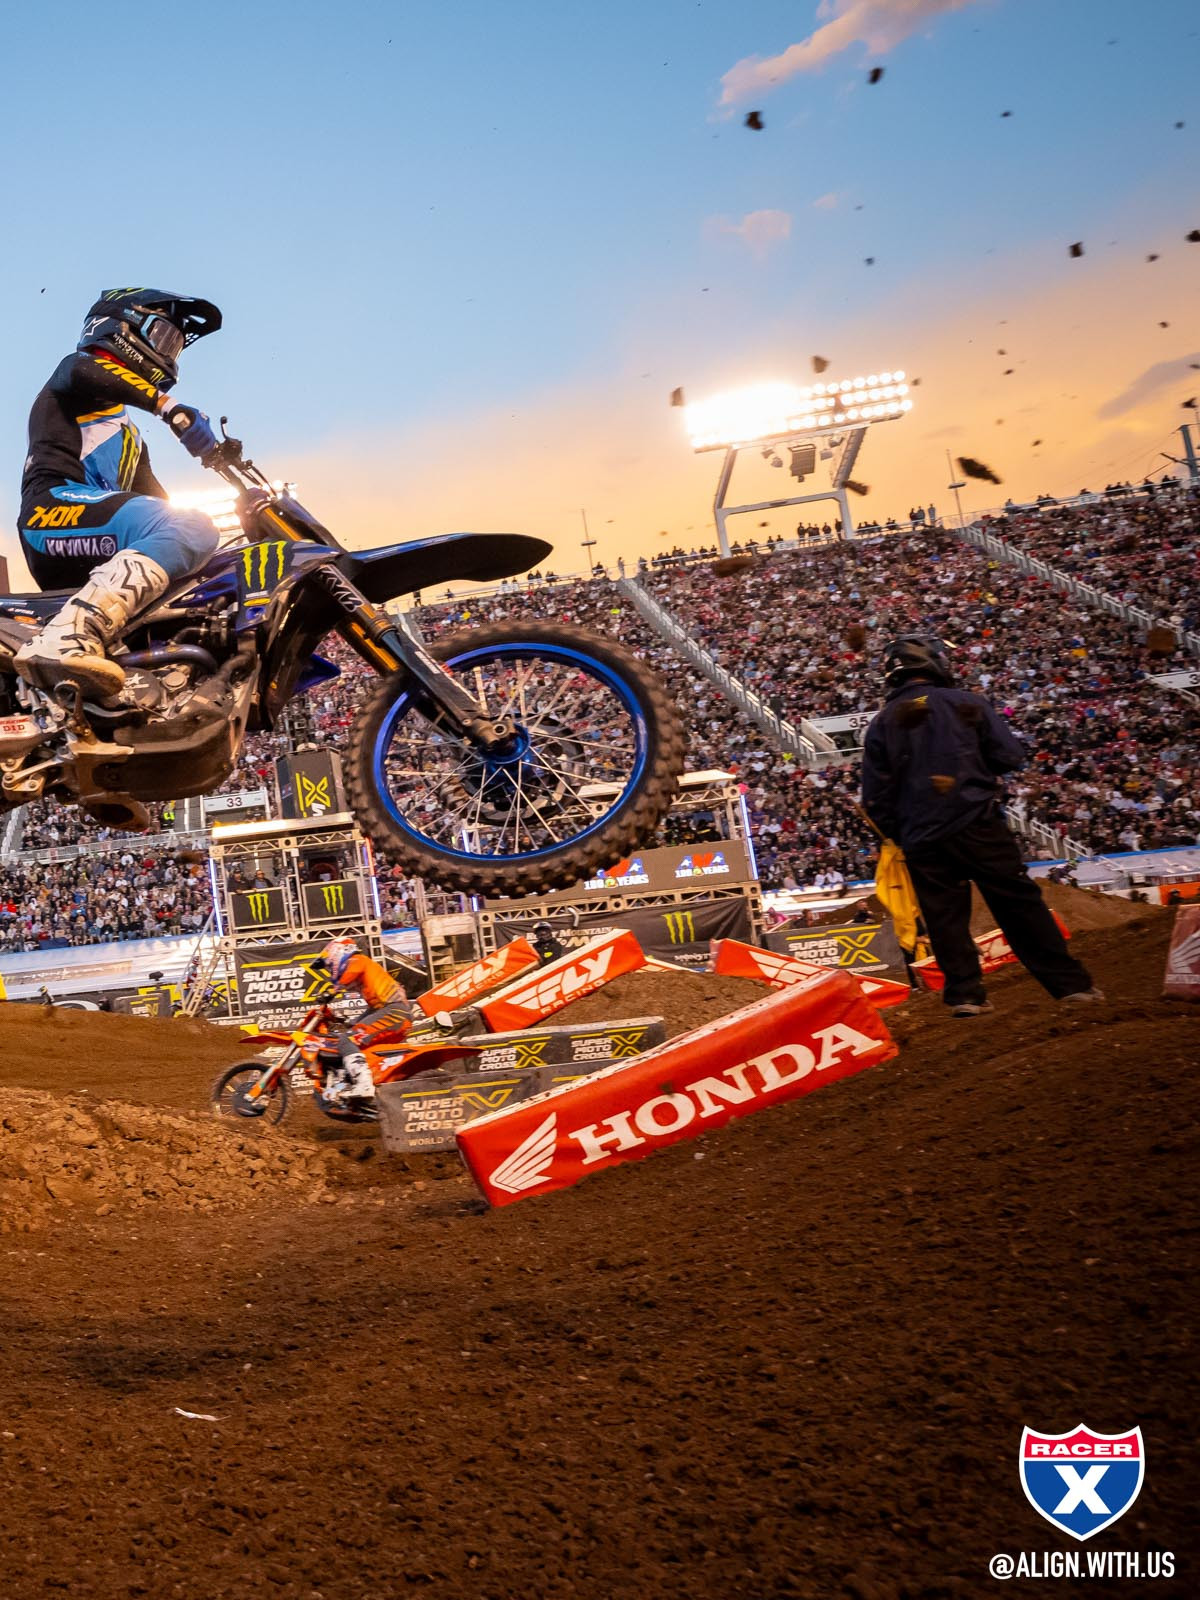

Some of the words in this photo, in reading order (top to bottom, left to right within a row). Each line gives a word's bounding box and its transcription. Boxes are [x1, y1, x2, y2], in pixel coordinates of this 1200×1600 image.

[46, 538, 100, 557] YAMAHA
[1189, 674, 1200, 684] 3
[849, 716, 868, 728] 35
[226, 797, 243, 808] 33
[788, 939, 838, 952] SUPER
[794, 948, 838, 960] MOTO
[242, 967, 306, 982] SUPER
[247, 979, 304, 993] MOTO
[244, 989, 306, 1004] CROSS
[539, 979, 607, 1015] RACING
[571, 1037, 612, 1048] SUPER
[574, 1045, 611, 1054] MOTO
[481, 1054, 515, 1064] MOTO
[572, 1051, 612, 1061] CROSS
[479, 1061, 517, 1071] CROSS
[568, 1023, 884, 1165] HONDA
[402, 1096, 465, 1112] SUPER
[407, 1108, 464, 1122] MOTO
[404, 1119, 466, 1133] CROSS
[408, 1136, 444, 1147] WORLD
